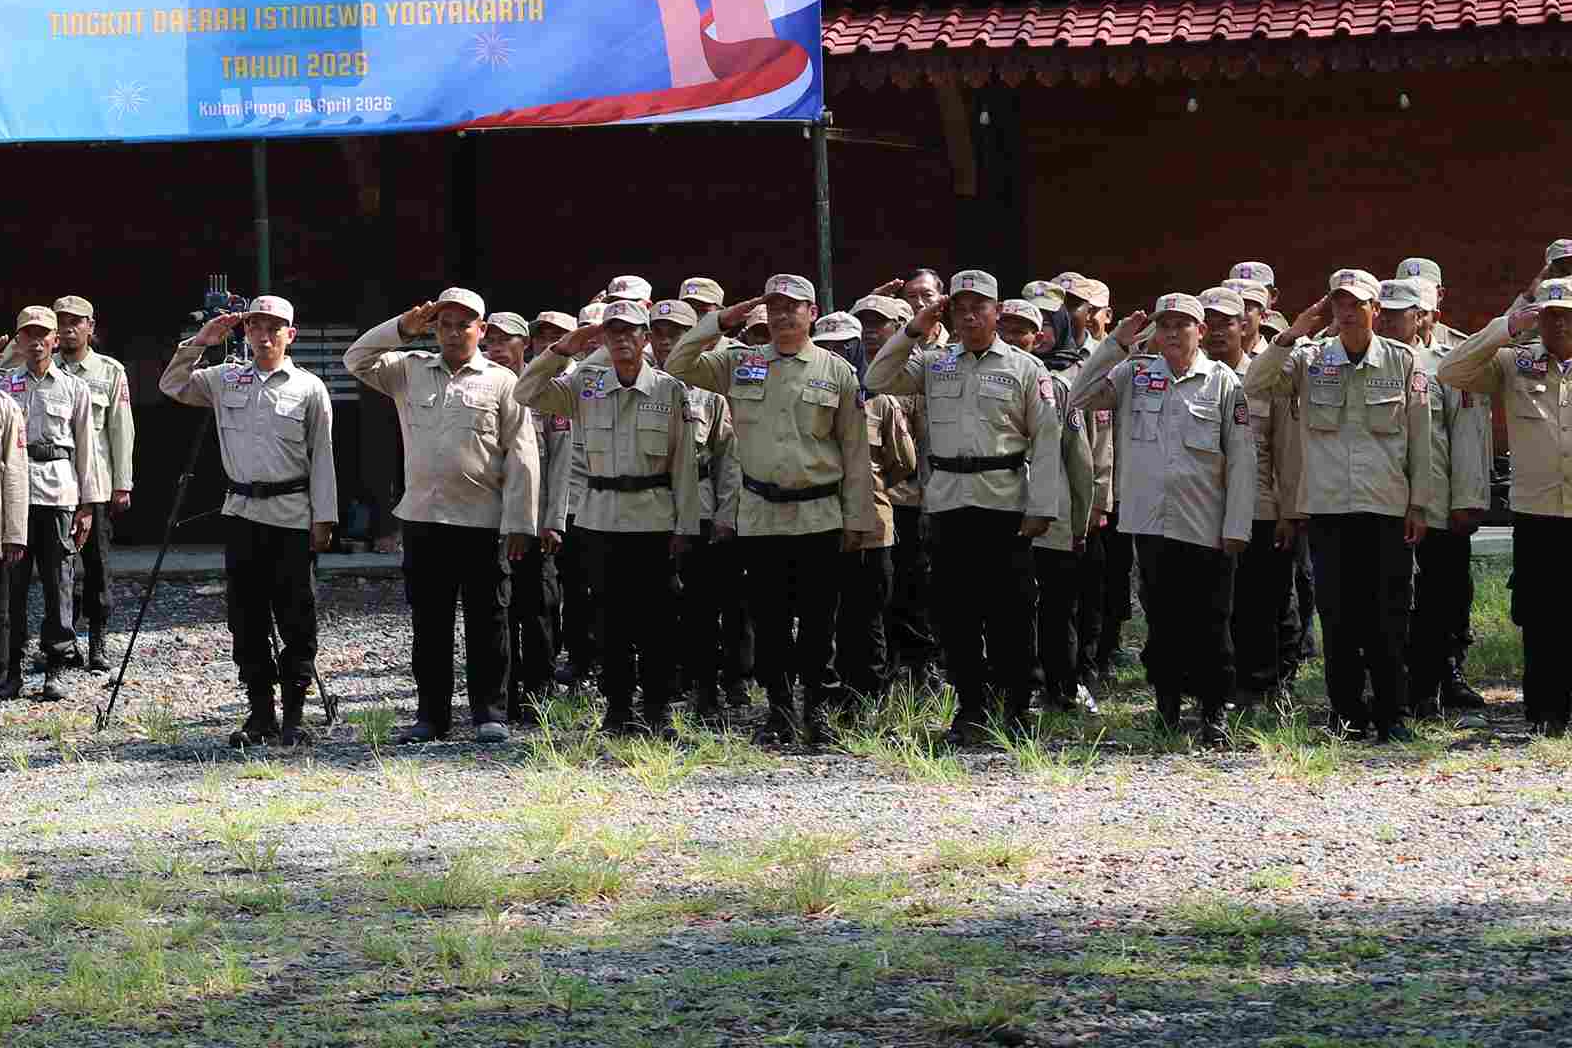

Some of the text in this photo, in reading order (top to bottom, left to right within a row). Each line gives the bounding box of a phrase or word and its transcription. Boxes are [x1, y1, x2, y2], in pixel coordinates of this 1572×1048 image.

[48, 10, 144, 39] TINGKAT
[153, 7, 247, 34] DAERAH
[253, 2, 379, 30] ISTIMEWA
[221, 55, 299, 80] TAHUN
[199, 101, 241, 117] Kulon
[316, 97, 351, 116] April
[355, 96, 395, 113] 2026
